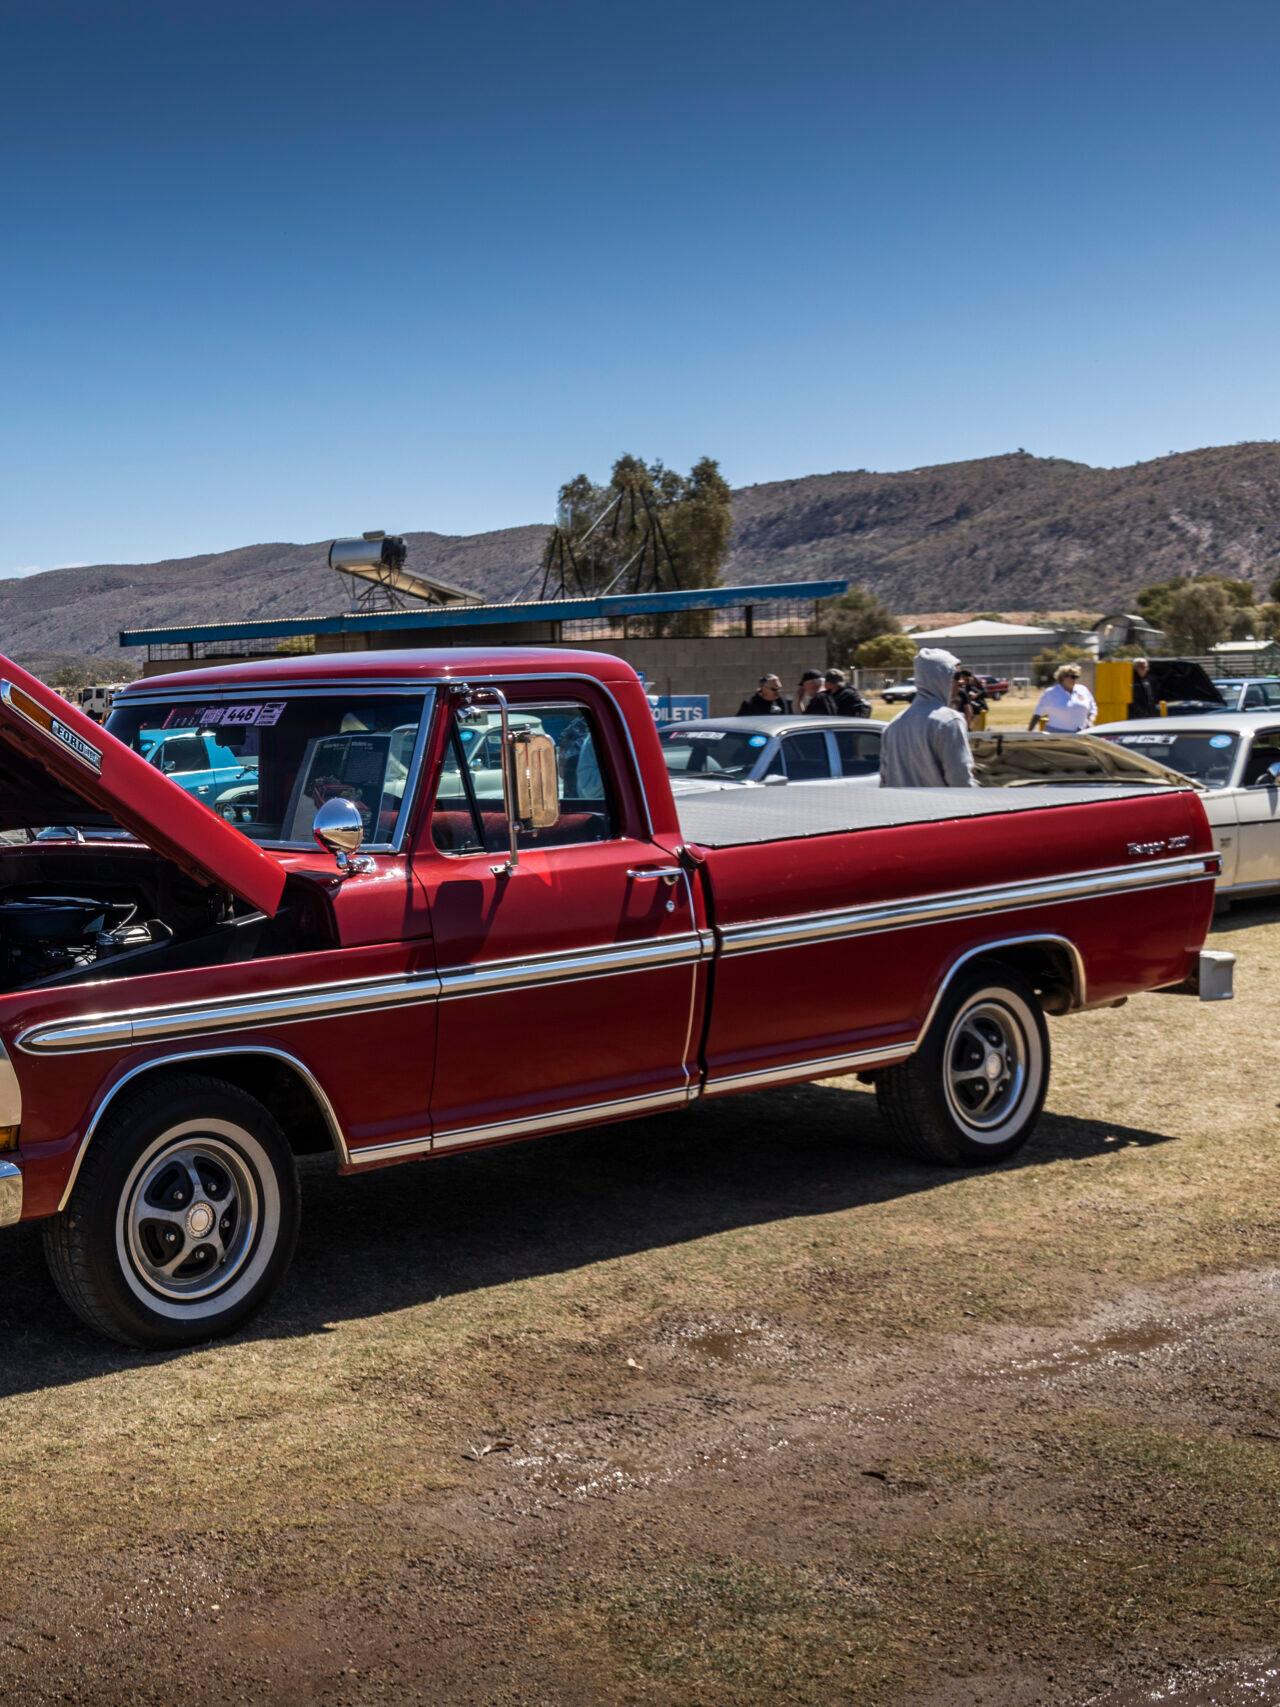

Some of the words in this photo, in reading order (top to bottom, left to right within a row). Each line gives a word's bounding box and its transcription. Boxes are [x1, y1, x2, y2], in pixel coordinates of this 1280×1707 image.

[227, 708, 256, 722] 446
[650, 706, 704, 721] OILETS
[56, 725, 85, 753] FORD
